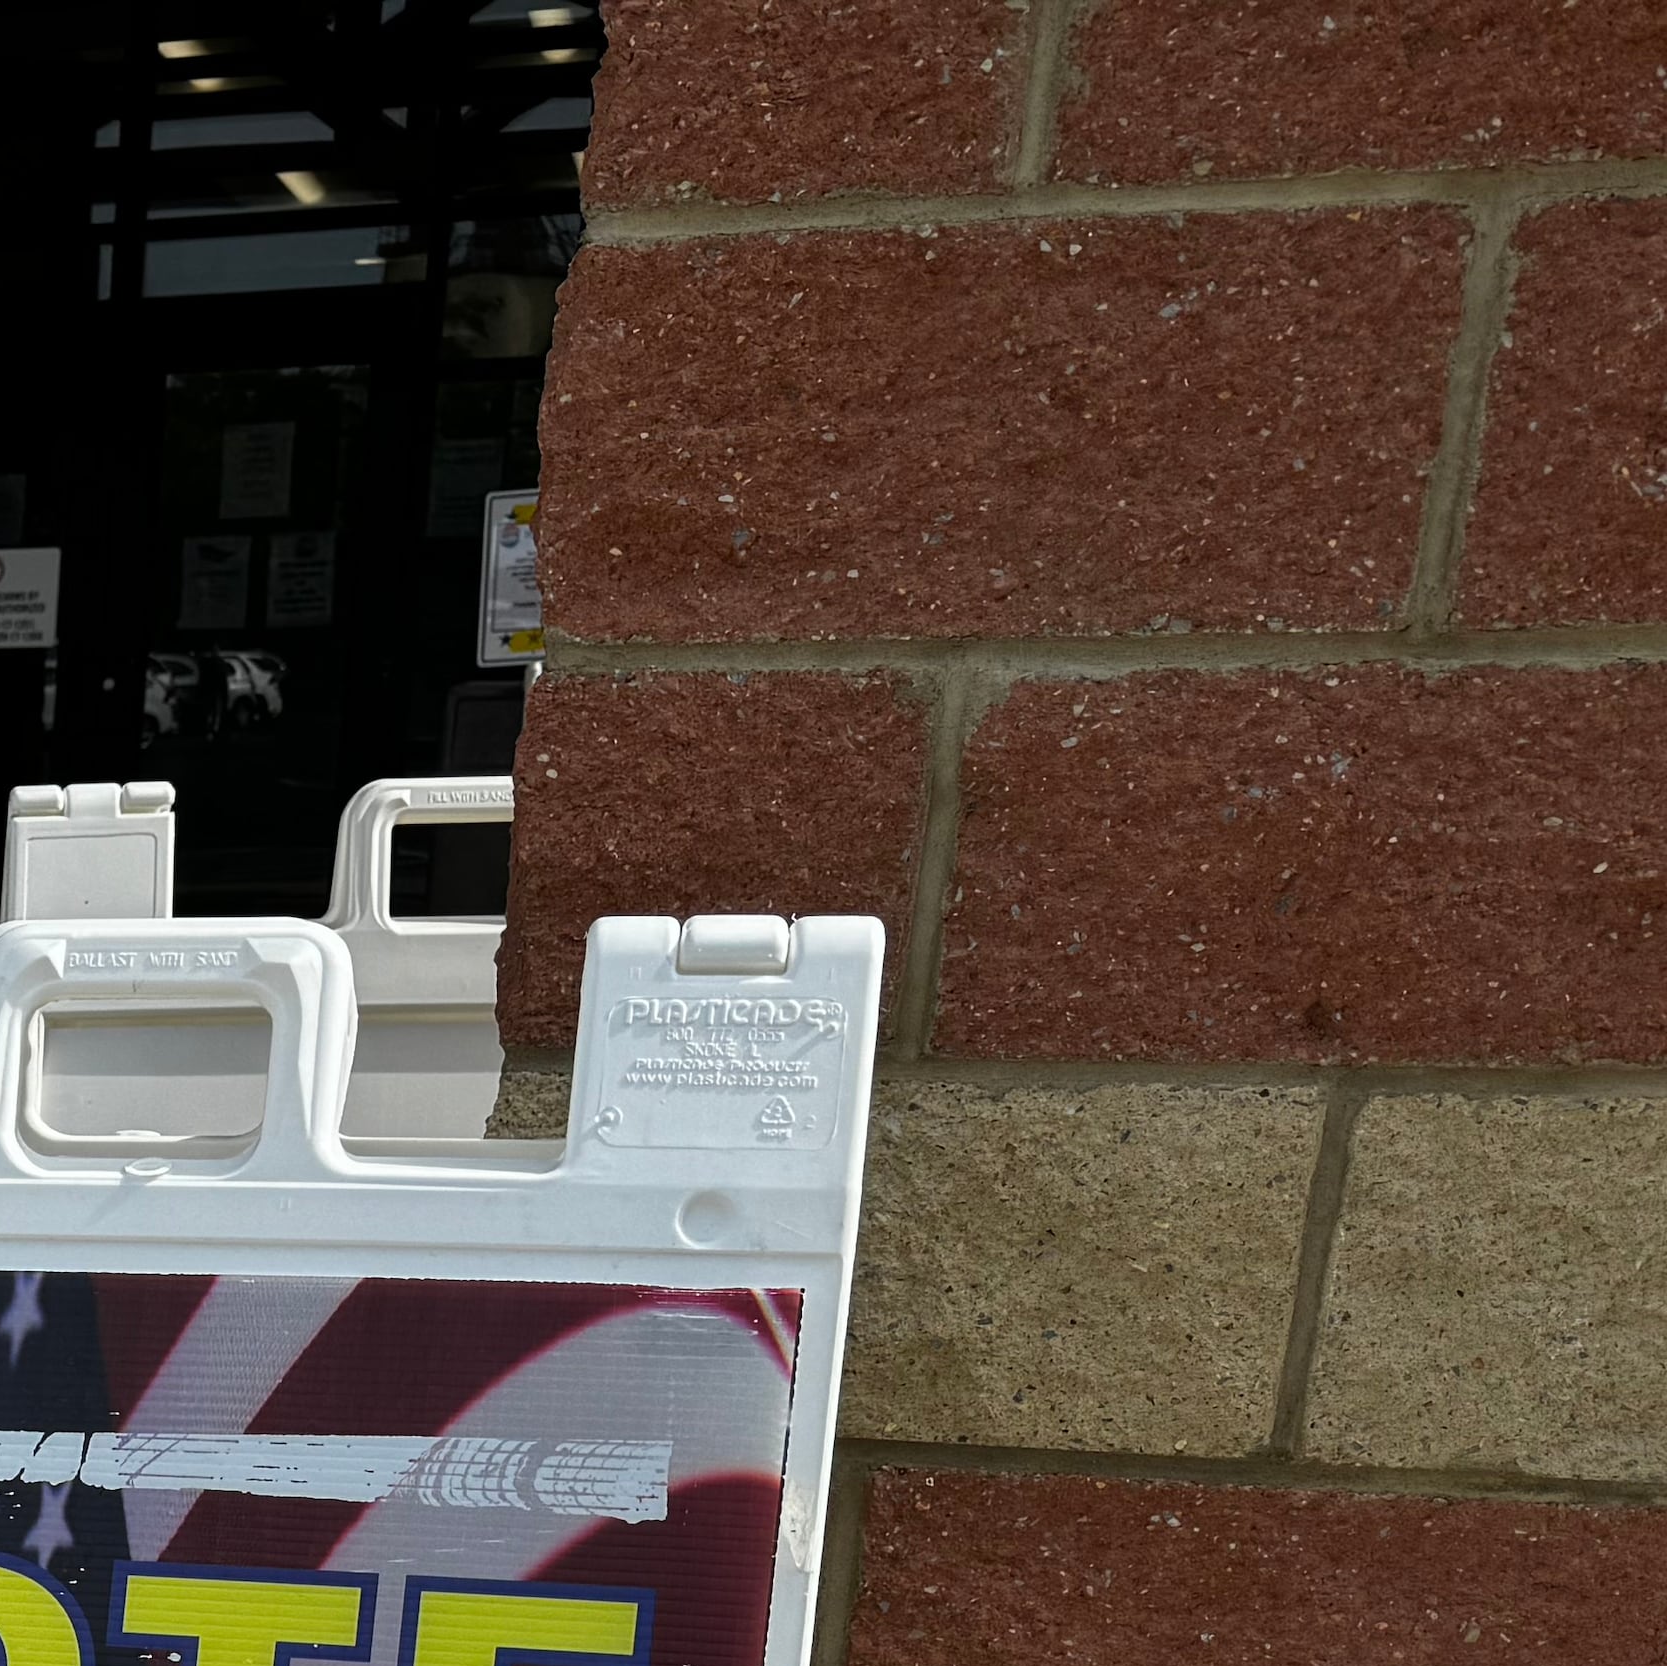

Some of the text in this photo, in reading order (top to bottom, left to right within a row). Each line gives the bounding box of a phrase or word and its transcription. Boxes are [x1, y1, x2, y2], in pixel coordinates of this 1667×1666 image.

[69, 951, 238, 967] BALLAST WITH SAND
[627, 998, 824, 1025] PLASTICADE
